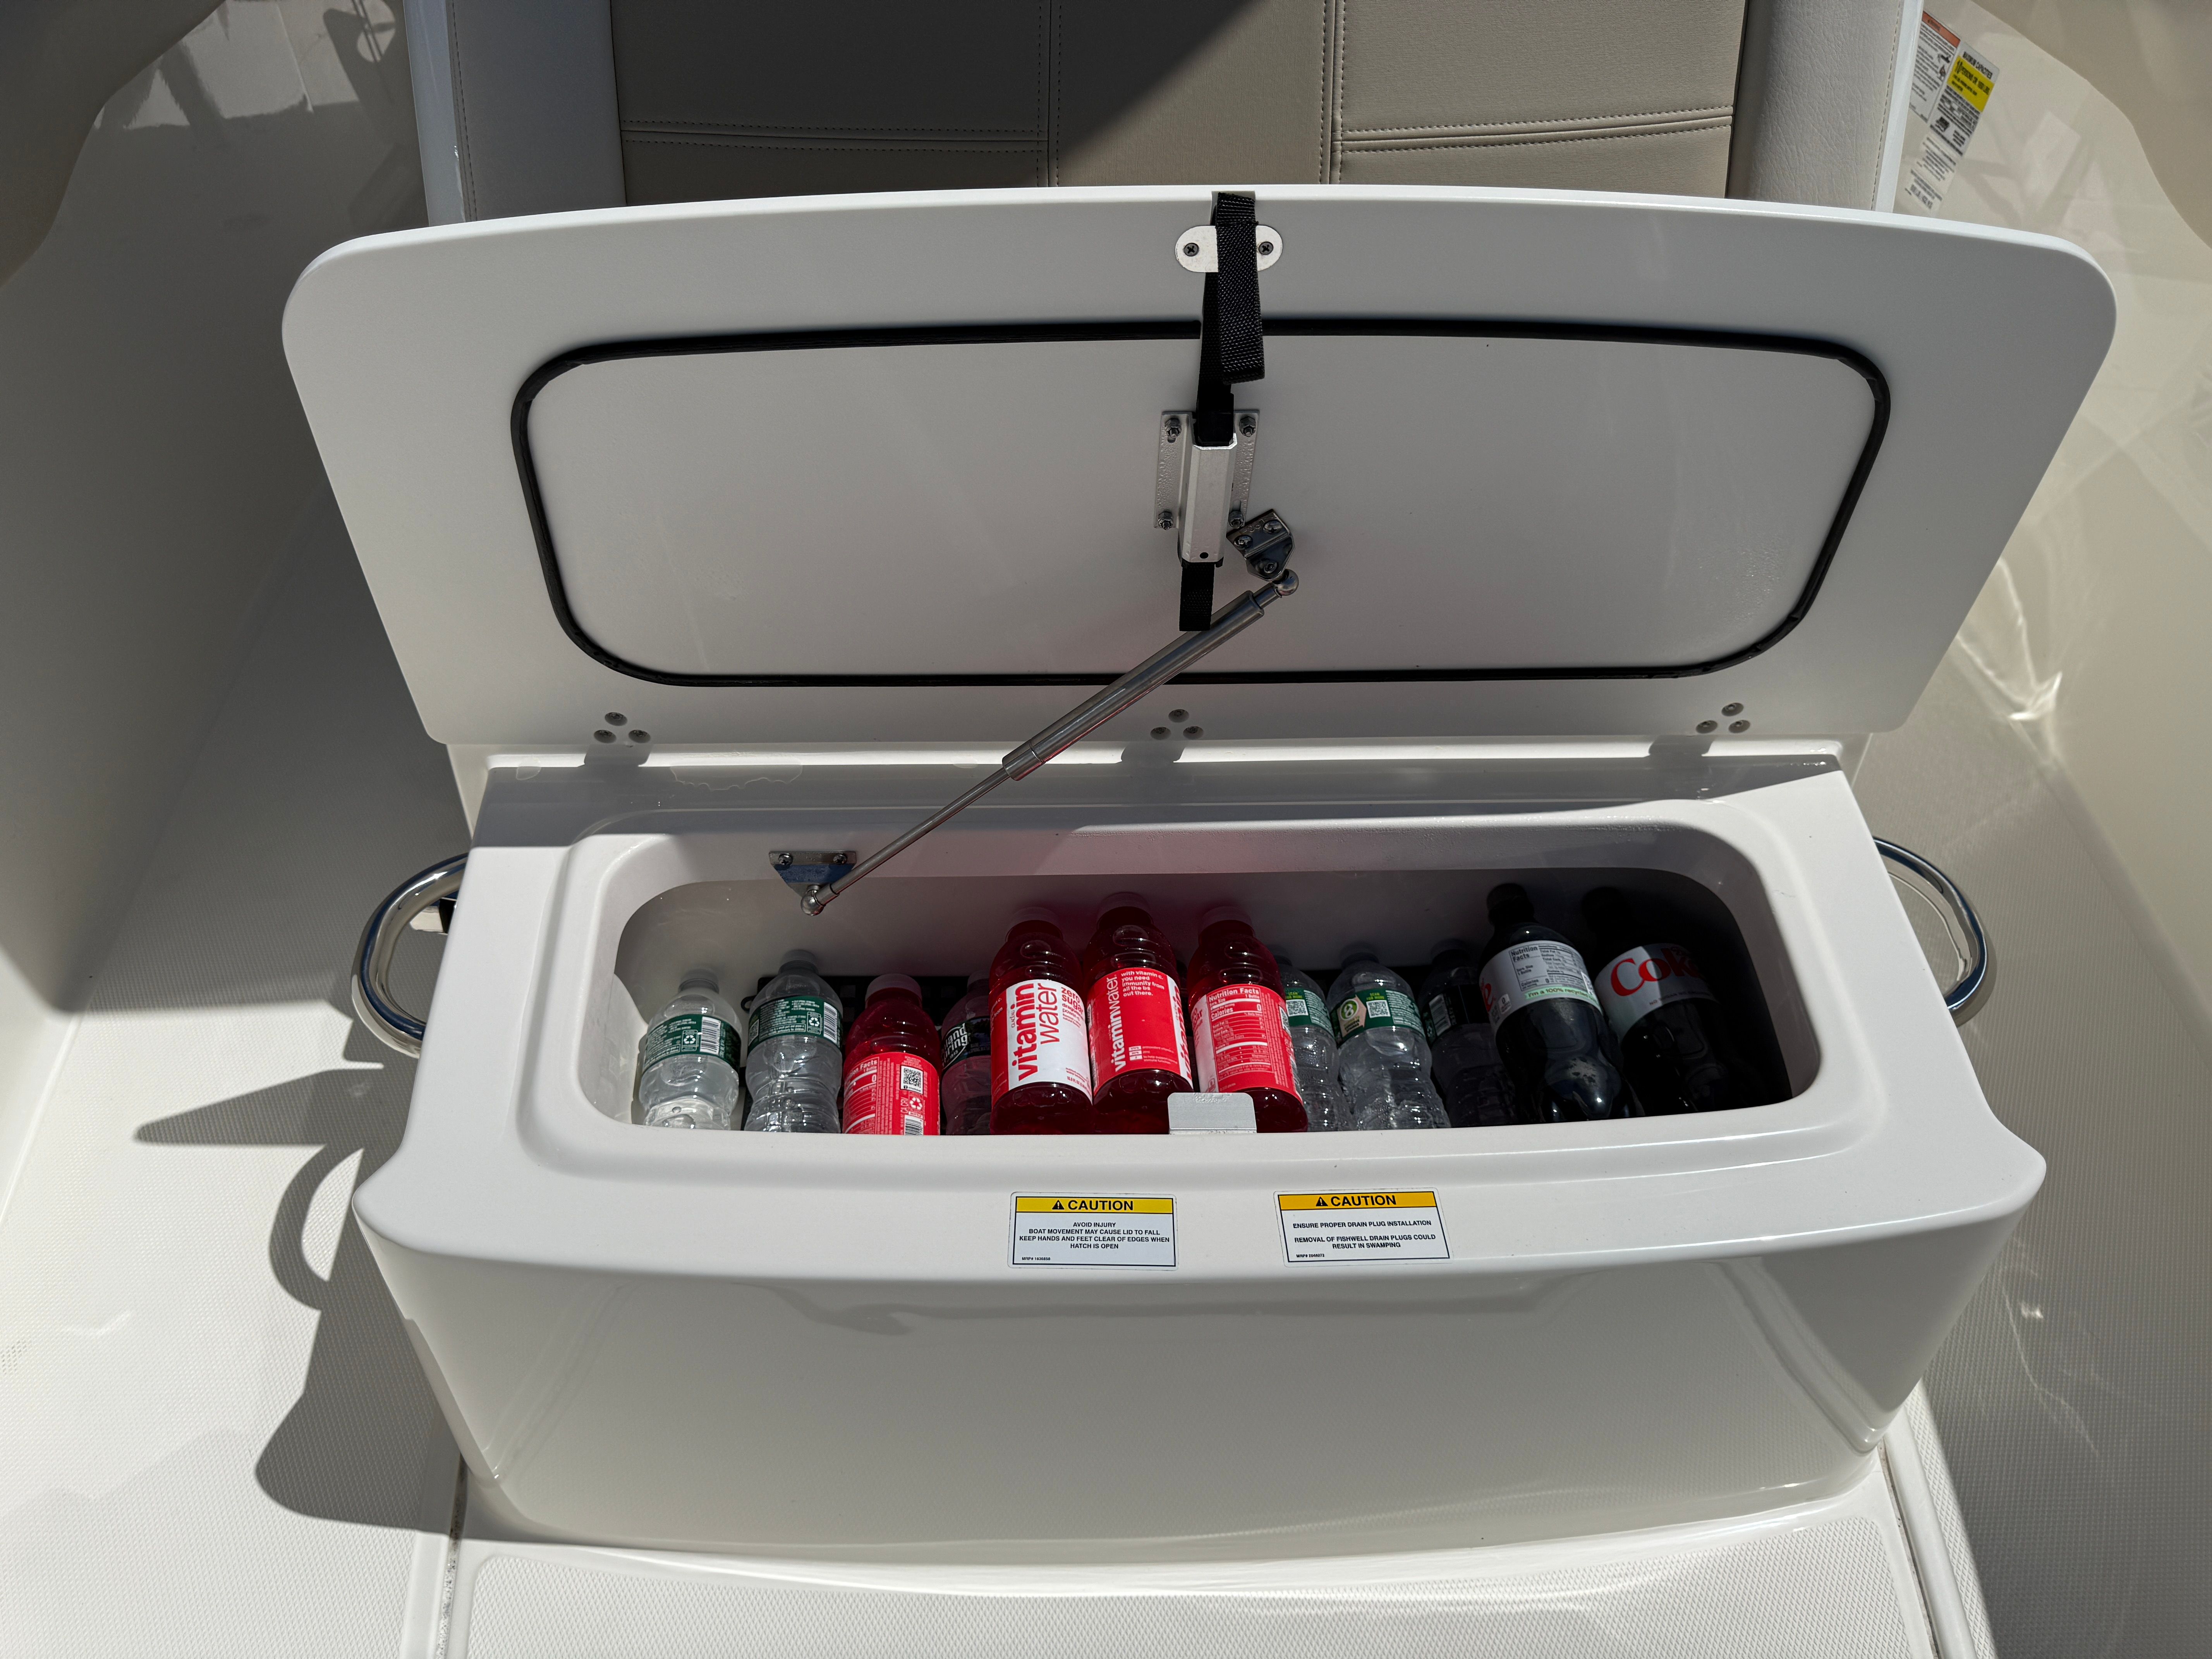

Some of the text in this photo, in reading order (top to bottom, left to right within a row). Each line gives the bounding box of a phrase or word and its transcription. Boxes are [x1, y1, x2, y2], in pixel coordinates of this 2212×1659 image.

[1511, 946, 1538, 956] Nutrition
[1513, 953, 1530, 962] Facts
[1152, 982, 1165, 990] from
[1061, 987, 1080, 1003] zero
[1209, 989, 1238, 1002] Nutrition
[1062, 994, 1083, 1015] sugar
[1036, 982, 1060, 1045] water
[1211, 1008, 1233, 1019] Calories
[1107, 975, 1126, 1072] vitaminwater
[1012, 983, 1038, 1082] vitamin
[860, 1060, 878, 1070] Facts
[872, 1074, 877, 1082] 0
[1068, 1200, 1133, 1210] CAUTION
[1331, 1195, 1396, 1206] CAUTION
